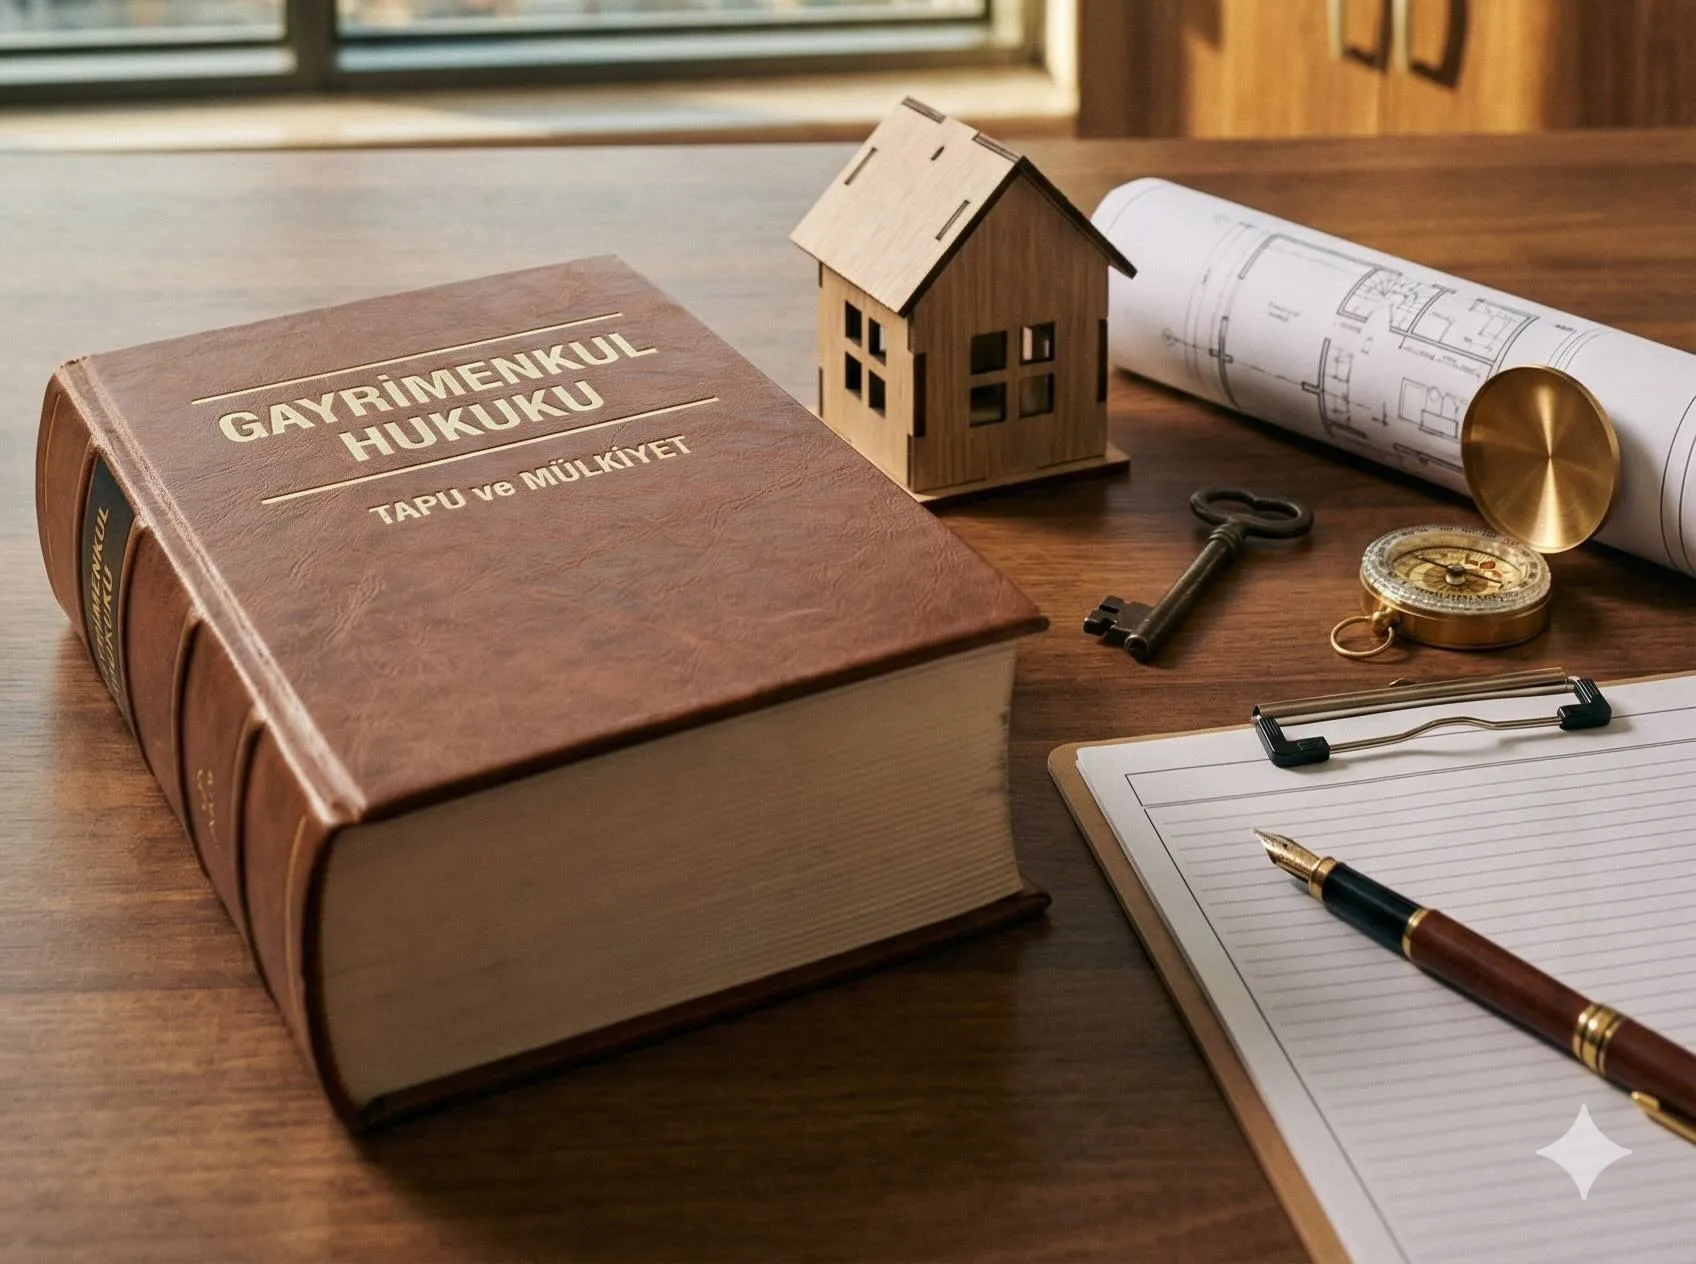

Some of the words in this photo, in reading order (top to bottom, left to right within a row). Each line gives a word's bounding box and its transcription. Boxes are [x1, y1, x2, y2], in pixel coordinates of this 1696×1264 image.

[218, 333, 658, 443] GAYRİMENKUL
[339, 381, 605, 463] HUKUKU
[369, 488, 466, 525] TAPU
[472, 481, 517, 503] ve
[519, 436, 692, 492] MÜLKİYET
